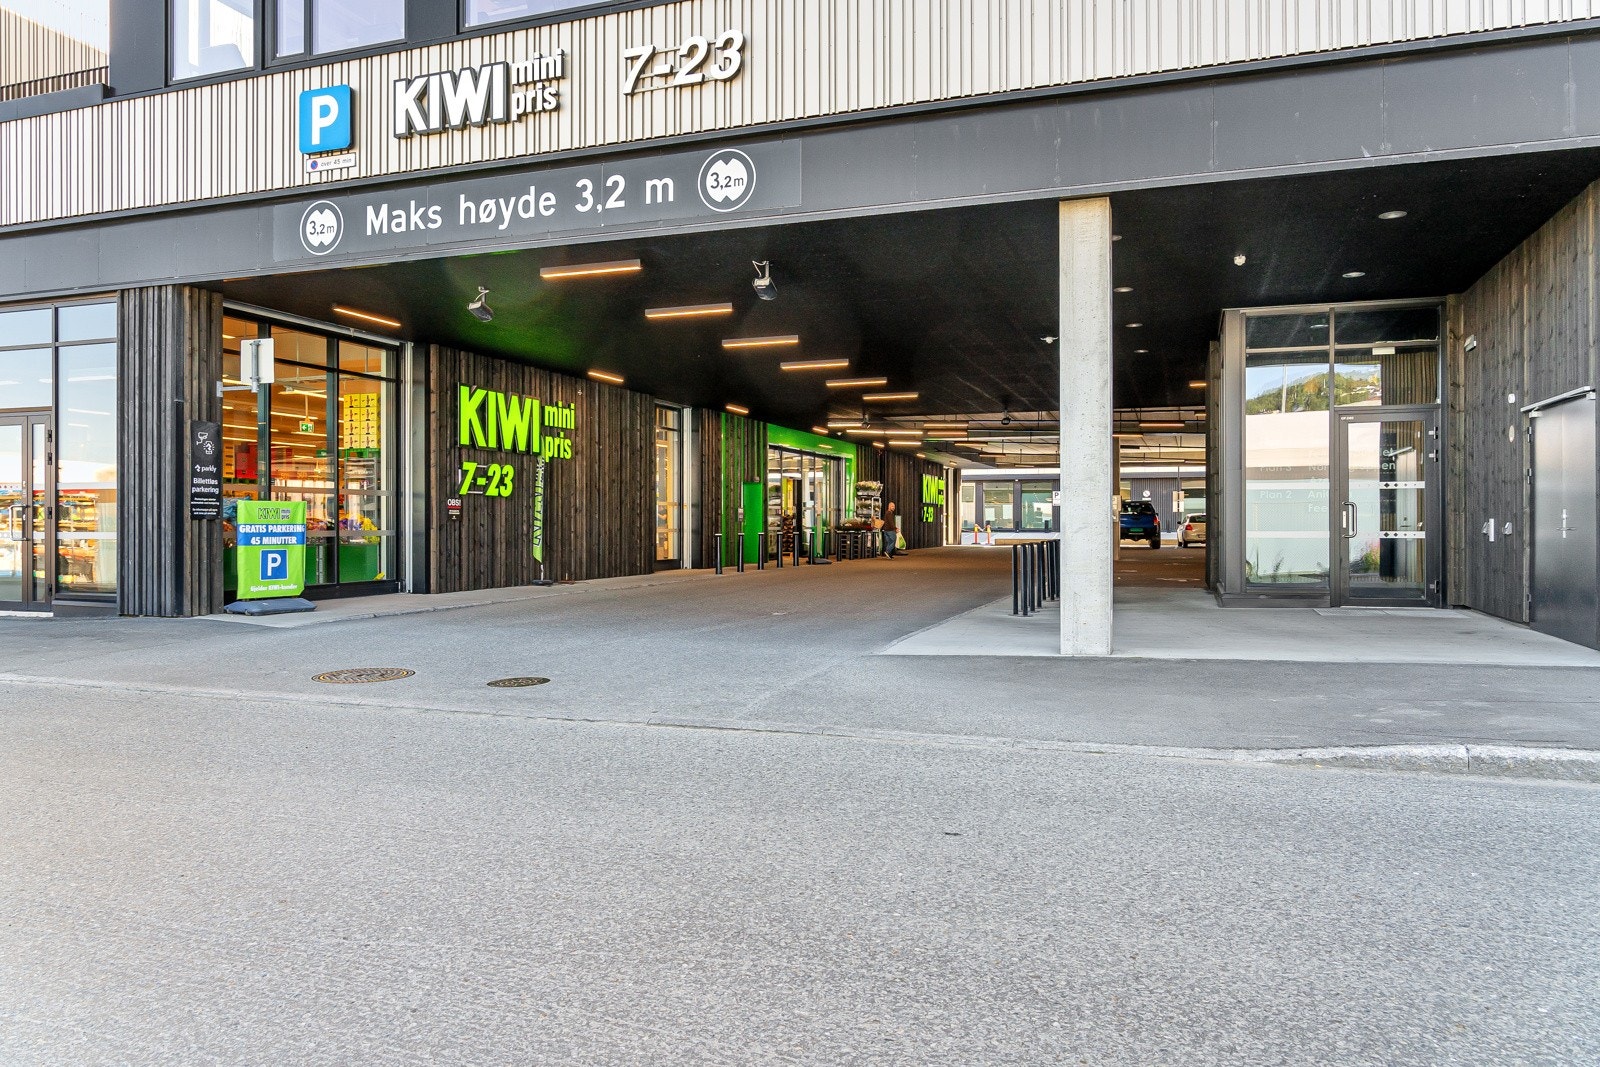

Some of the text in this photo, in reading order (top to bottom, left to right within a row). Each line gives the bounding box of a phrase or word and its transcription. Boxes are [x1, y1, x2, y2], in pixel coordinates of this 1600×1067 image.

[512, 48, 565, 85] mini
[623, 29, 745, 96] 7-23
[393, 61, 509, 139] KIWI
[511, 83, 560, 121] pris
[311, 94, 340, 146] P
[366, 174, 675, 236] Maks høyde 3,2 m
[458, 383, 541, 456] KIWI
[544, 401, 576, 430] mini
[544, 432, 572, 463] pris
[191, 486, 219, 494] parkering
[193, 477, 218, 485] Billettløs
[459, 461, 515, 498] 7-23
[1259, 490, 1283, 499] Plan
[1286, 490, 1292, 499] 2
[239, 524, 305, 533] GRATIS PARKERING
[257, 507, 281, 520] KIWI
[250, 536, 297, 545] 45 MINUTTER
[267, 553, 282, 577] P
